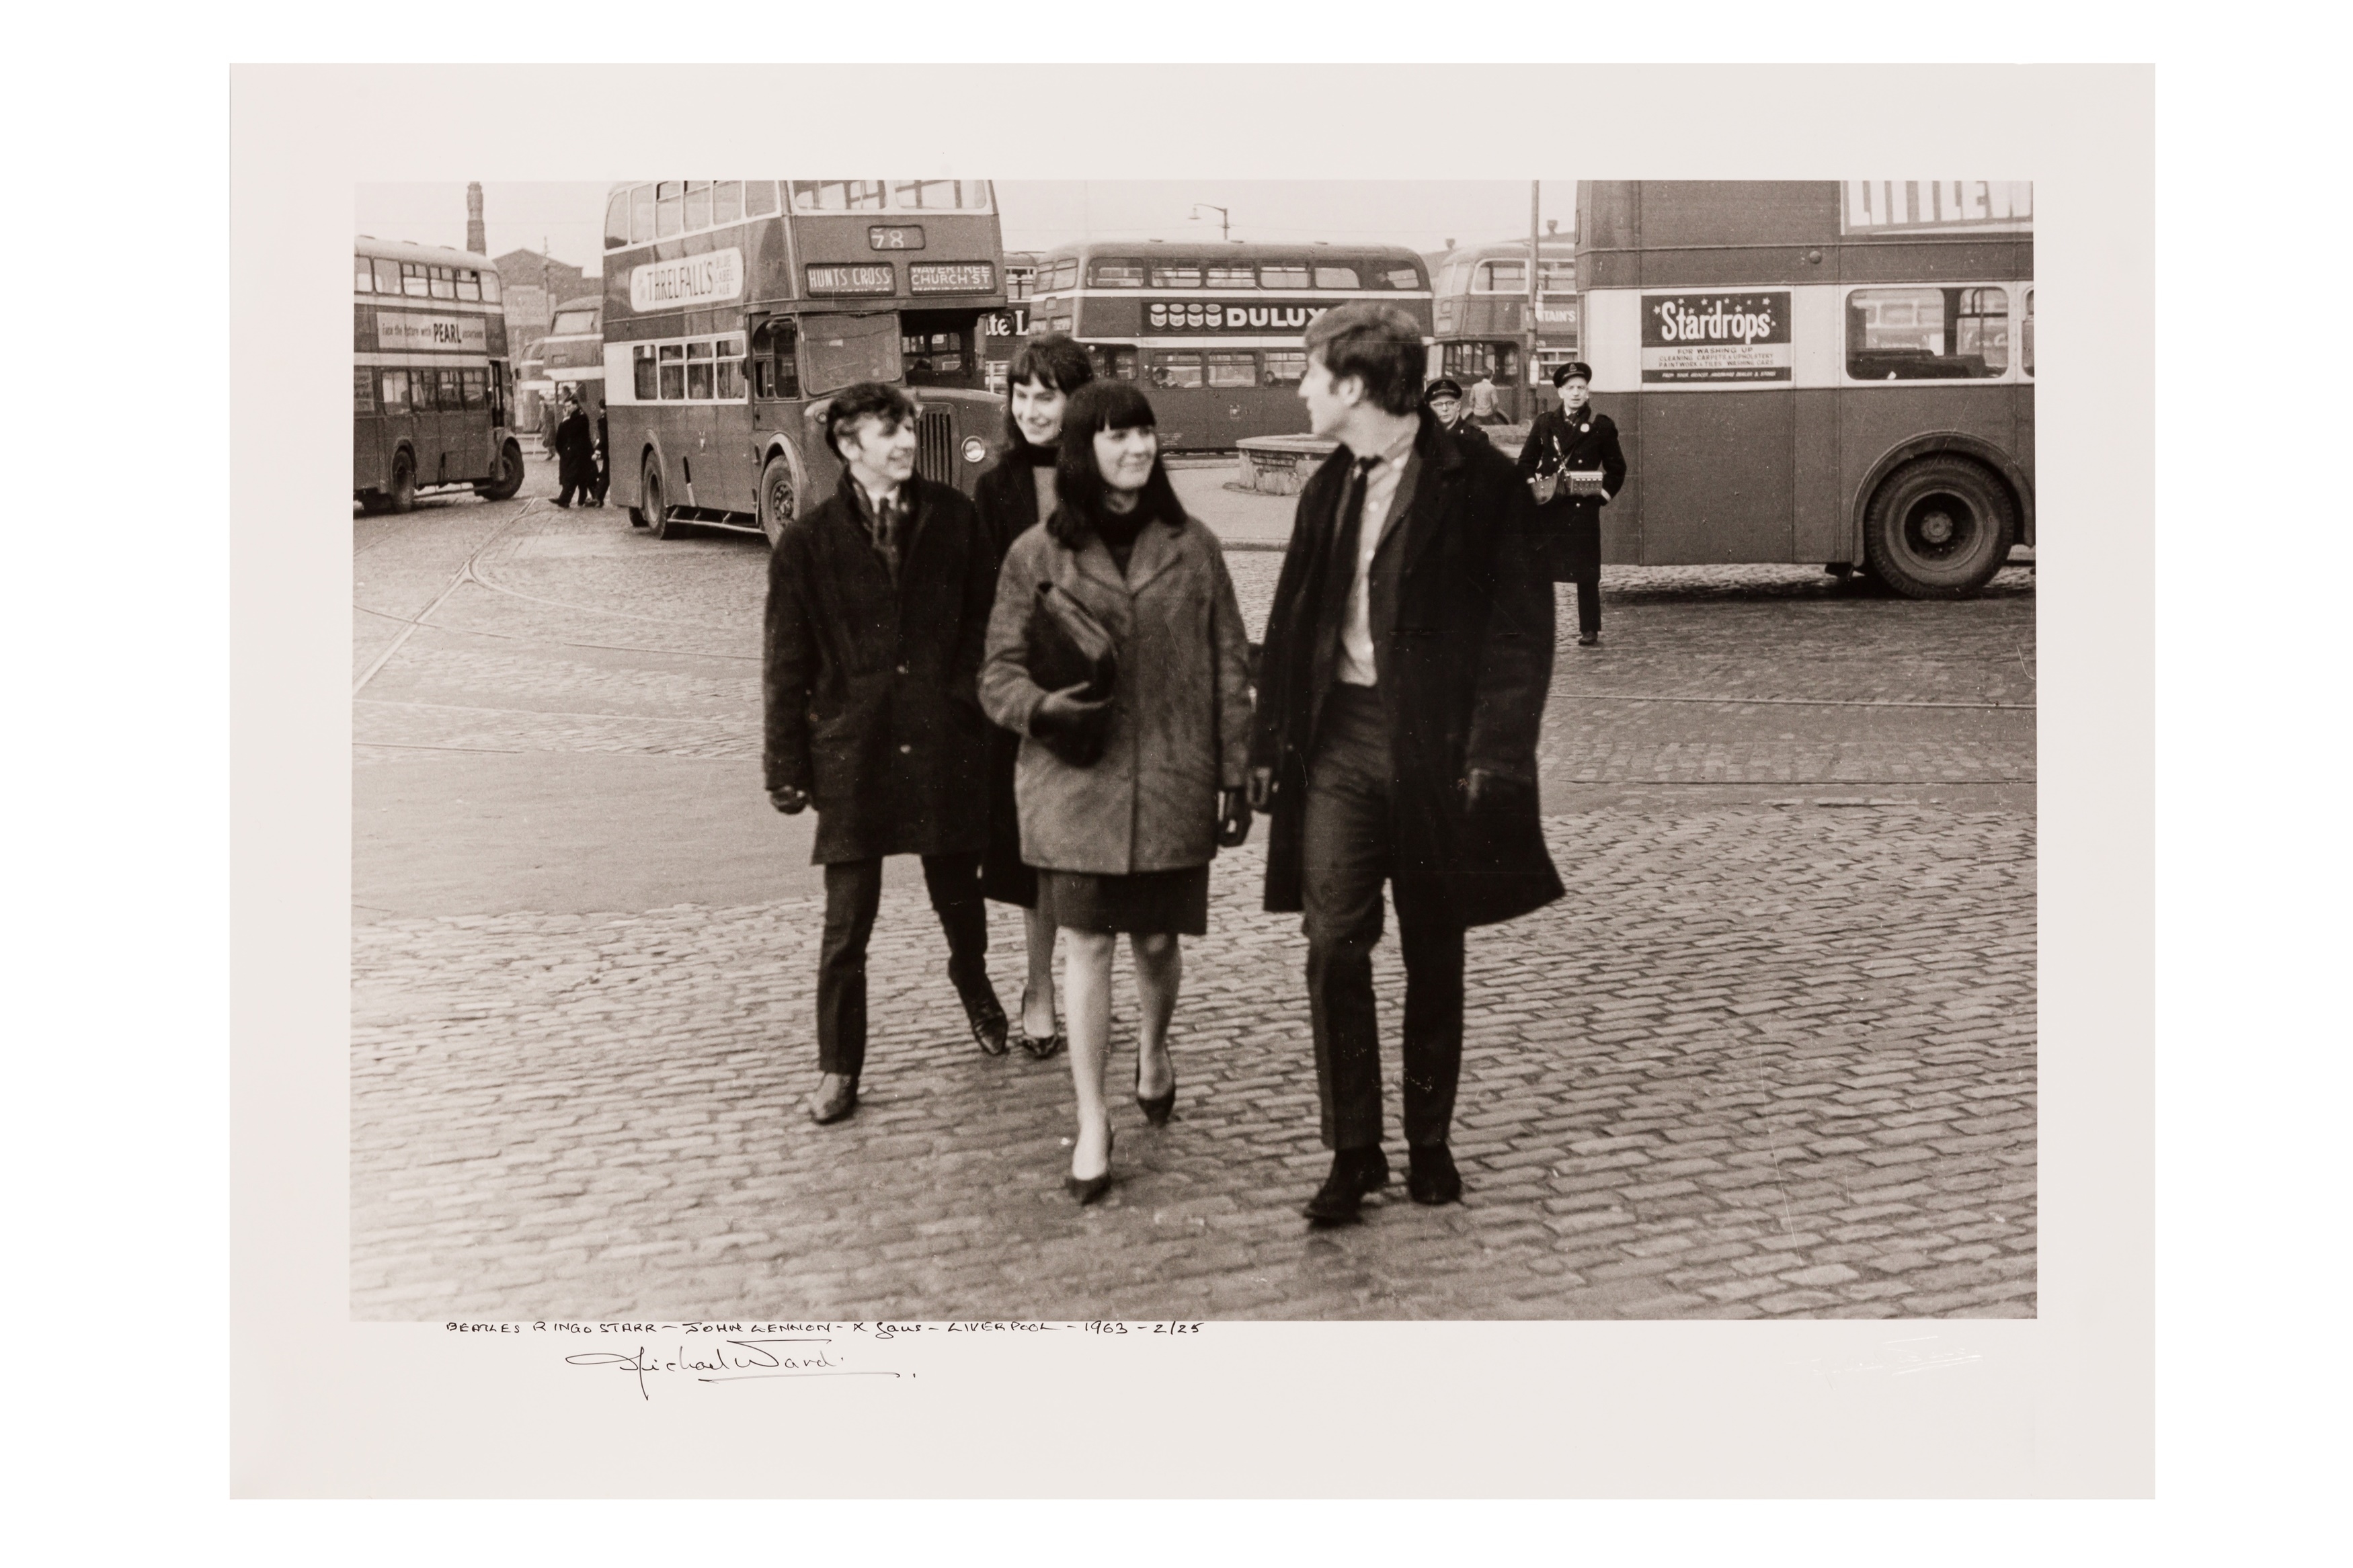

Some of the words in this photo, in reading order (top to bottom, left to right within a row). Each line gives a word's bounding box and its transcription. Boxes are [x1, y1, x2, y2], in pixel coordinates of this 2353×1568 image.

[871, 230, 904, 248] 78
[647, 260, 713, 301] THRELFALL'S
[808, 267, 848, 288] HUNTS
[852, 267, 891, 286] CROSS
[911, 274, 968, 285] CHURCH
[971, 274, 990, 284] ST
[1226, 308, 1328, 327] DULUX
[1661, 300, 1771, 345] Stardrops
[433, 323, 462, 343] PEARL
[446, 1321, 520, 1333] BEATLES
[533, 1321, 592, 1333] RINGO
[600, 1323, 657, 1333] STARR
[682, 1321, 744, 1335] JOHN
[751, 1322, 831, 1333] LENNON
[947, 1321, 1062, 1332] LIVERPOOL
[1084, 1320, 1128, 1335] 1963
[1152, 1320, 1205, 1335] 2/25
